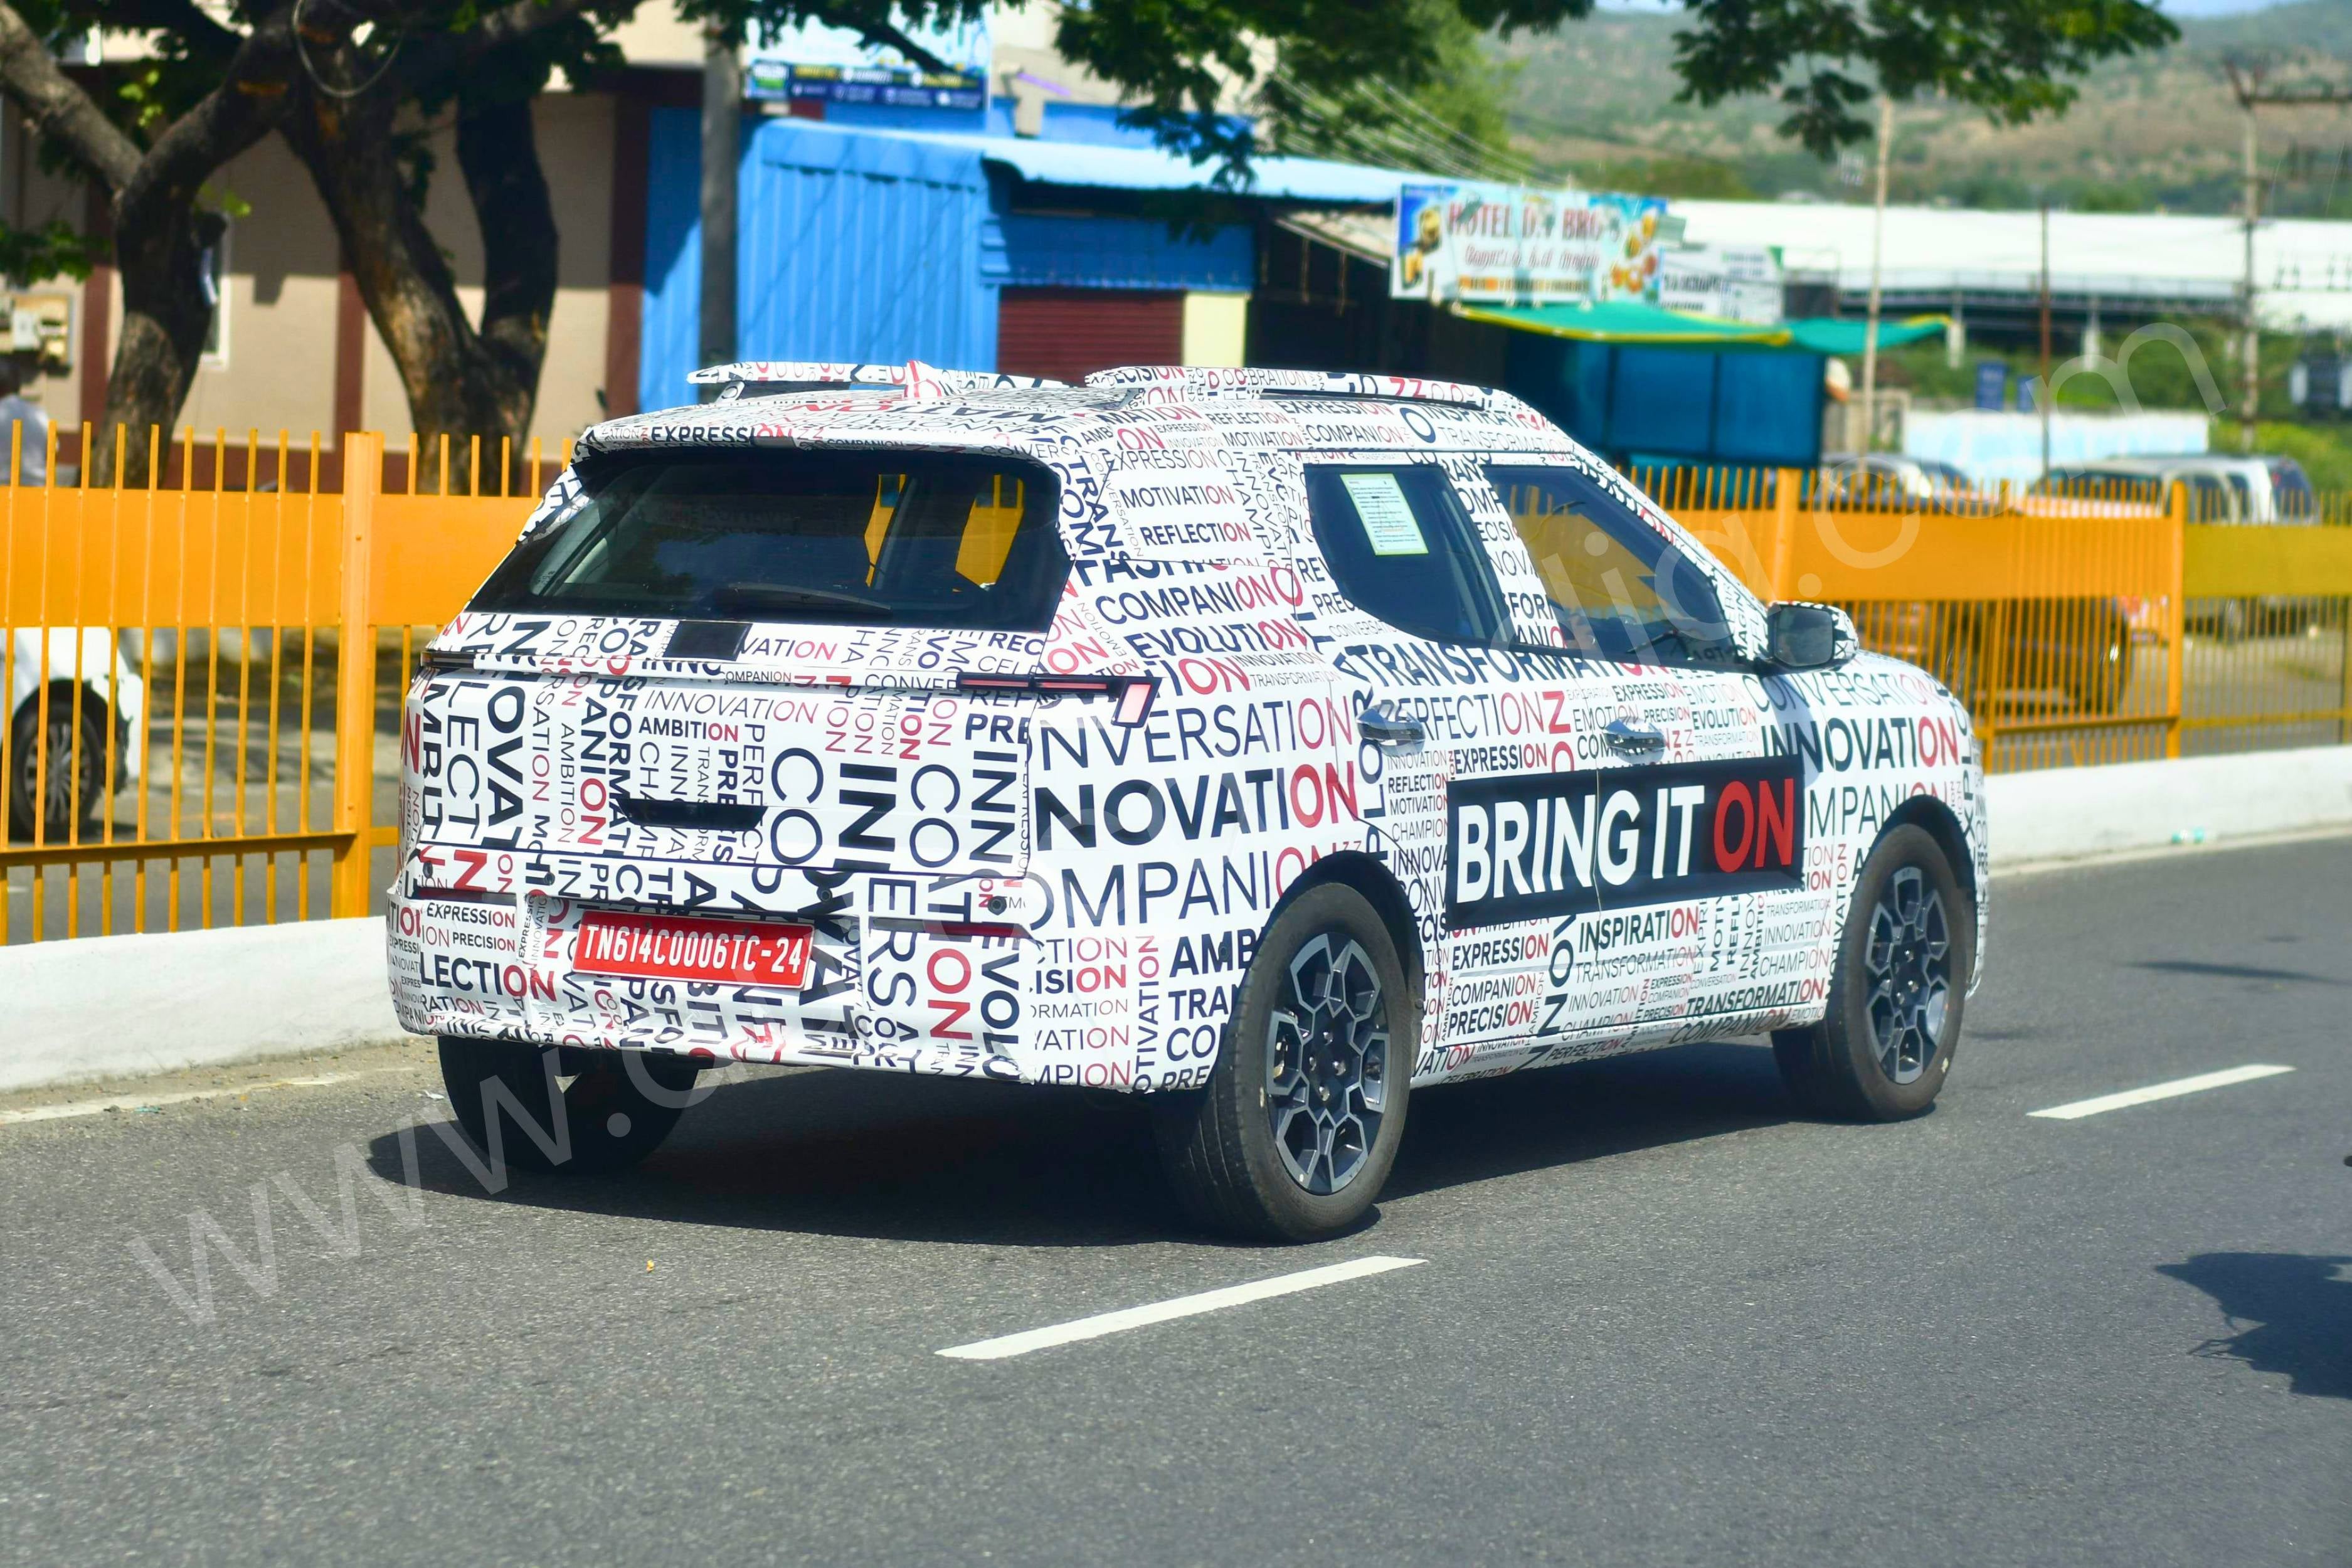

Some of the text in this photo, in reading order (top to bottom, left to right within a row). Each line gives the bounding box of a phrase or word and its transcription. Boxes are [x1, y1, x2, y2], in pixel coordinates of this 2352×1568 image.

[1205, 411, 1291, 425] REFLECTION
[1222, 431, 1303, 447] MOTIVATION
[1306, 424, 1406, 443] COMPANION
[1102, 449, 1216, 472] EXPRESSION
[1120, 485, 1234, 509] MOTIVATION
[1141, 522, 1251, 546] REFLECTION
[1095, 574, 1274, 625] COMPANION
[1124, 617, 1308, 659] EVOLUTION
[1234, 652, 1325, 669] INNOVATION
[1250, 670, 1341, 688] TRANSFORMATION
[1742, 671, 1943, 712] CONVERSATION
[1612, 682, 1685, 702] EXPRESSION
[1682, 684, 1745, 705] EMOTION
[644, 689, 818, 724] INNOVATION
[1644, 706, 1691, 723] PRECISION
[1692, 707, 1757, 730] EVOLUTION
[638, 716, 738, 743] AMBITION
[1695, 730, 1759, 747] TRANSFORMATION
[1761, 716, 1959, 773] INNOVATION
[1454, 743, 1547, 774] EXPRESSION
[558, 723, 575, 843] AMBITION
[1387, 773, 1448, 795] REFLECTION
[1456, 778, 1794, 903] BRING IT ON
[427, 903, 515, 928] EXPRESSION
[1766, 898, 1831, 918] TRANSFORMATION
[453, 932, 515, 952] PRECISION
[1579, 906, 1698, 953] INSPIRATION
[1764, 919, 1831, 945] INNOVATION
[1169, 928, 1261, 978] AMB
[1451, 933, 1549, 971] EXPRESSION
[1576, 943, 1694, 983] TRANSFORMATION
[1760, 948, 1830, 977] CHAMPION
[1451, 973, 1536, 1007] COMPANION
[1651, 973, 1692, 990] EXPRESSION
[1690, 973, 1737, 990] CONVERSATION
[1569, 985, 1639, 1012] INNOVATION
[1648, 987, 1690, 1004] COMPANION
[1687, 977, 1825, 1015] TRANSFORMATION
[1448, 1000, 1534, 1037] PRECISION
[1644, 1003, 1687, 1020] PRECISION
[1560, 1012, 1633, 1041] CHAMPION
[1669, 1009, 1792, 1044] COMPANION
[1546, 1038, 1621, 1061] PERFECTION
